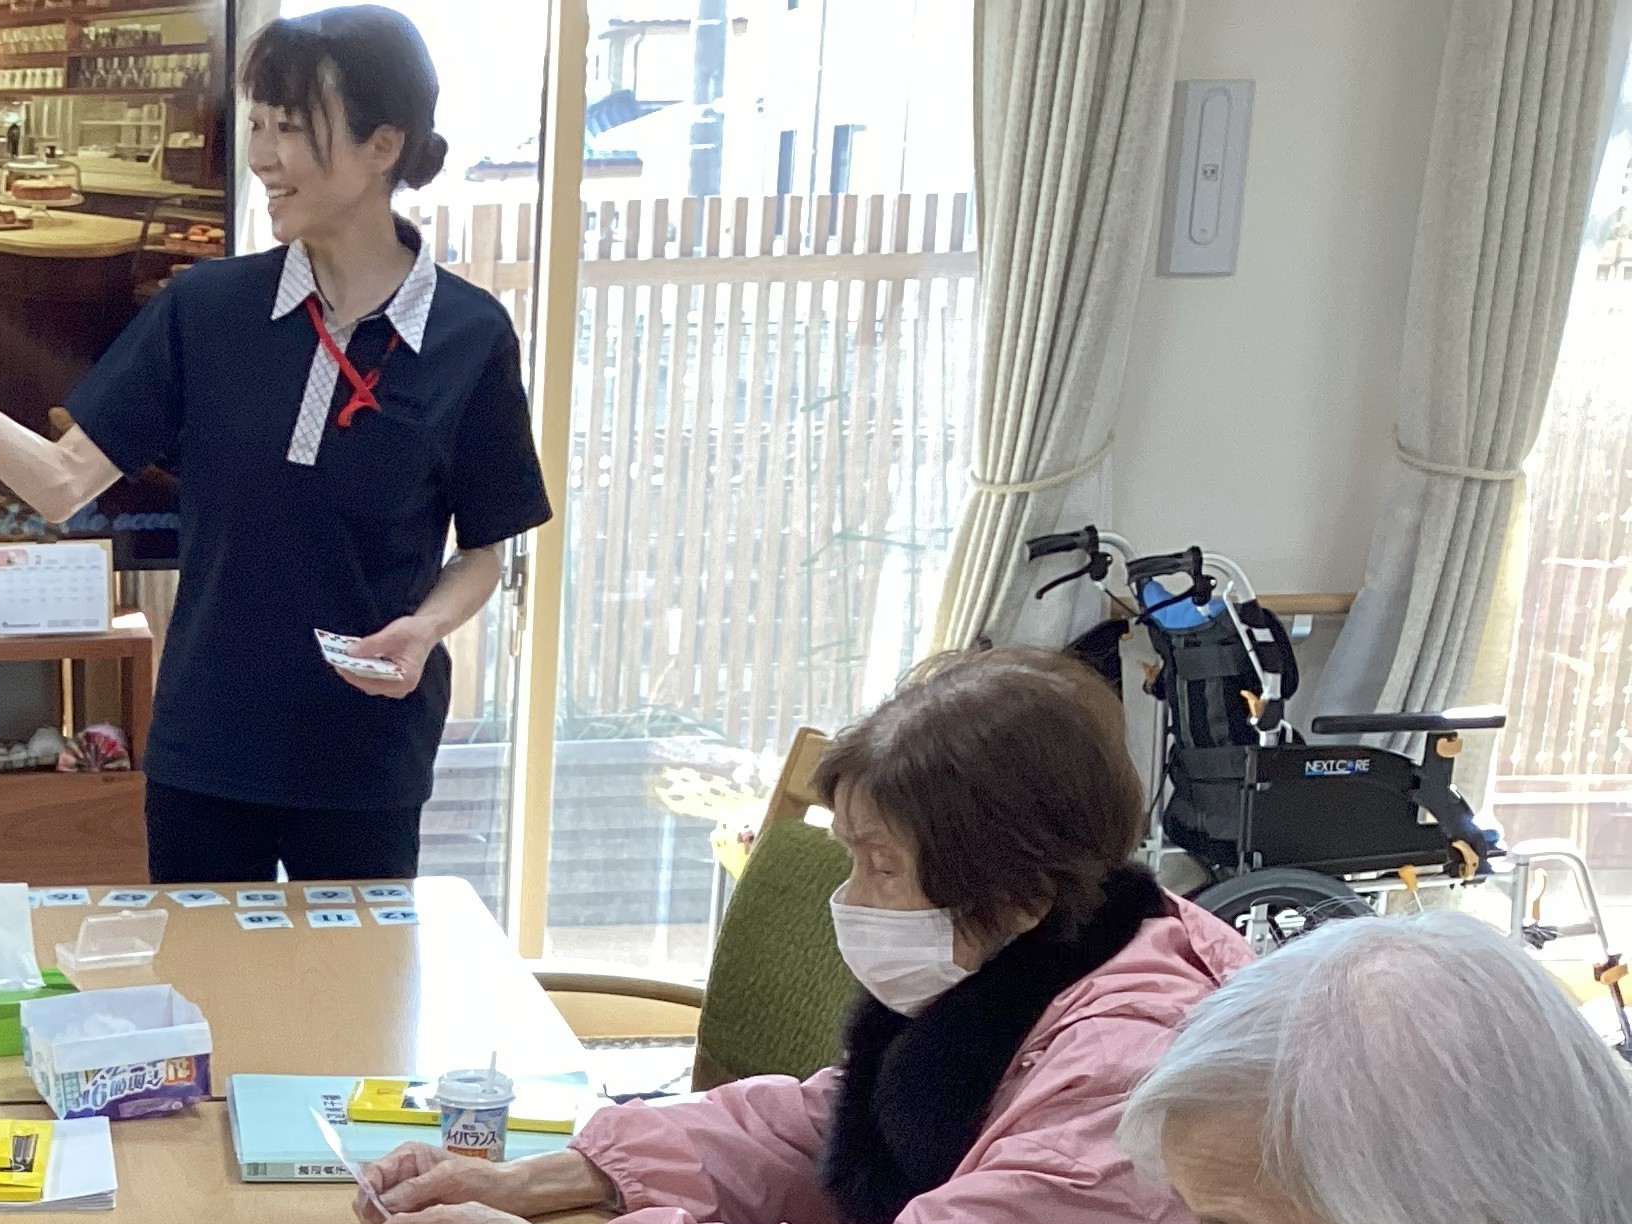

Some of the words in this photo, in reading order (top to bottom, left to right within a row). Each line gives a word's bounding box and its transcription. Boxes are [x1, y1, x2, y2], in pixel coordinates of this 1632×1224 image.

[446, 1128, 497, 1147] メイバランス
